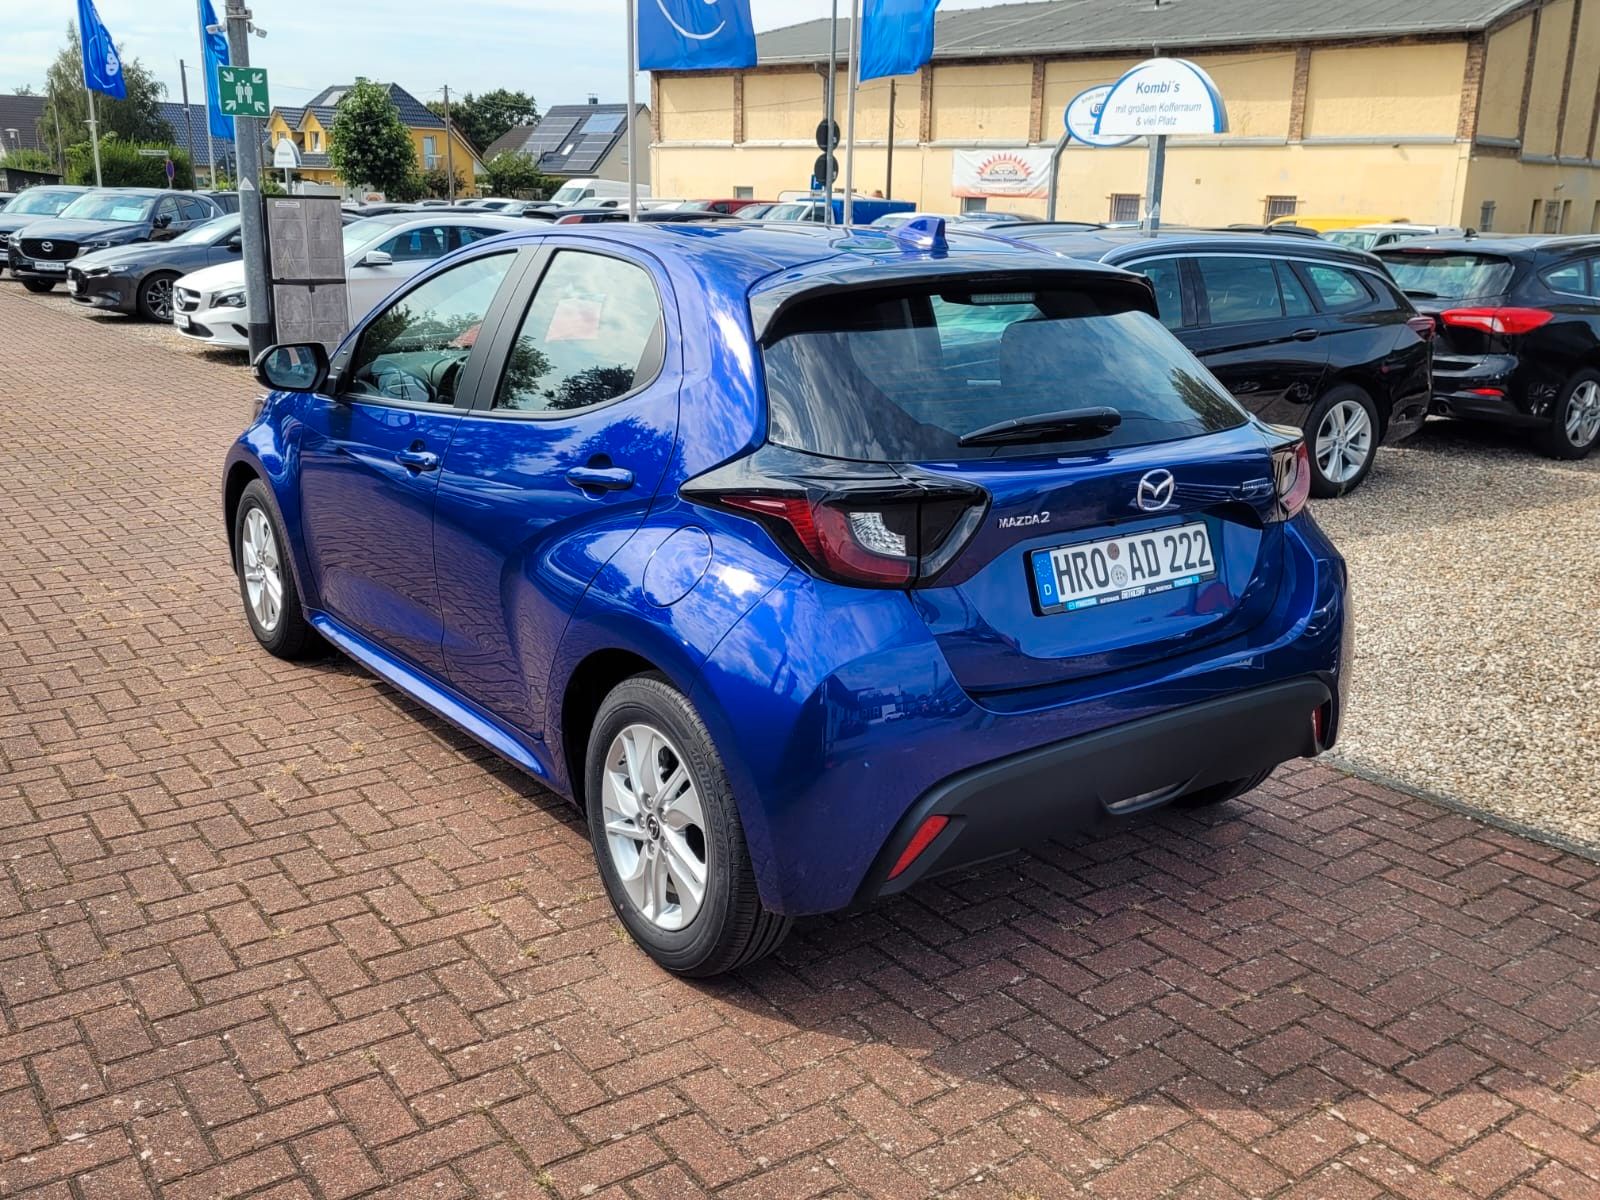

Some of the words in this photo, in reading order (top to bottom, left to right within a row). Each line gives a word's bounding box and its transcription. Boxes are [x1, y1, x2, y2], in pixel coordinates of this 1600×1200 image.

[1115, 103, 1127, 113] mit
[1128, 103, 1157, 115] großem
[1158, 102, 1202, 113] Kofferraum
[1136, 116, 1141, 125] &
[1143, 116, 1157, 125] viel
[1158, 116, 1177, 126] Platz
[1043, 583, 1052, 596] D
[1053, 547, 1110, 596] HRO
[1128, 538, 1161, 581] AD
[1163, 530, 1211, 573] 222
